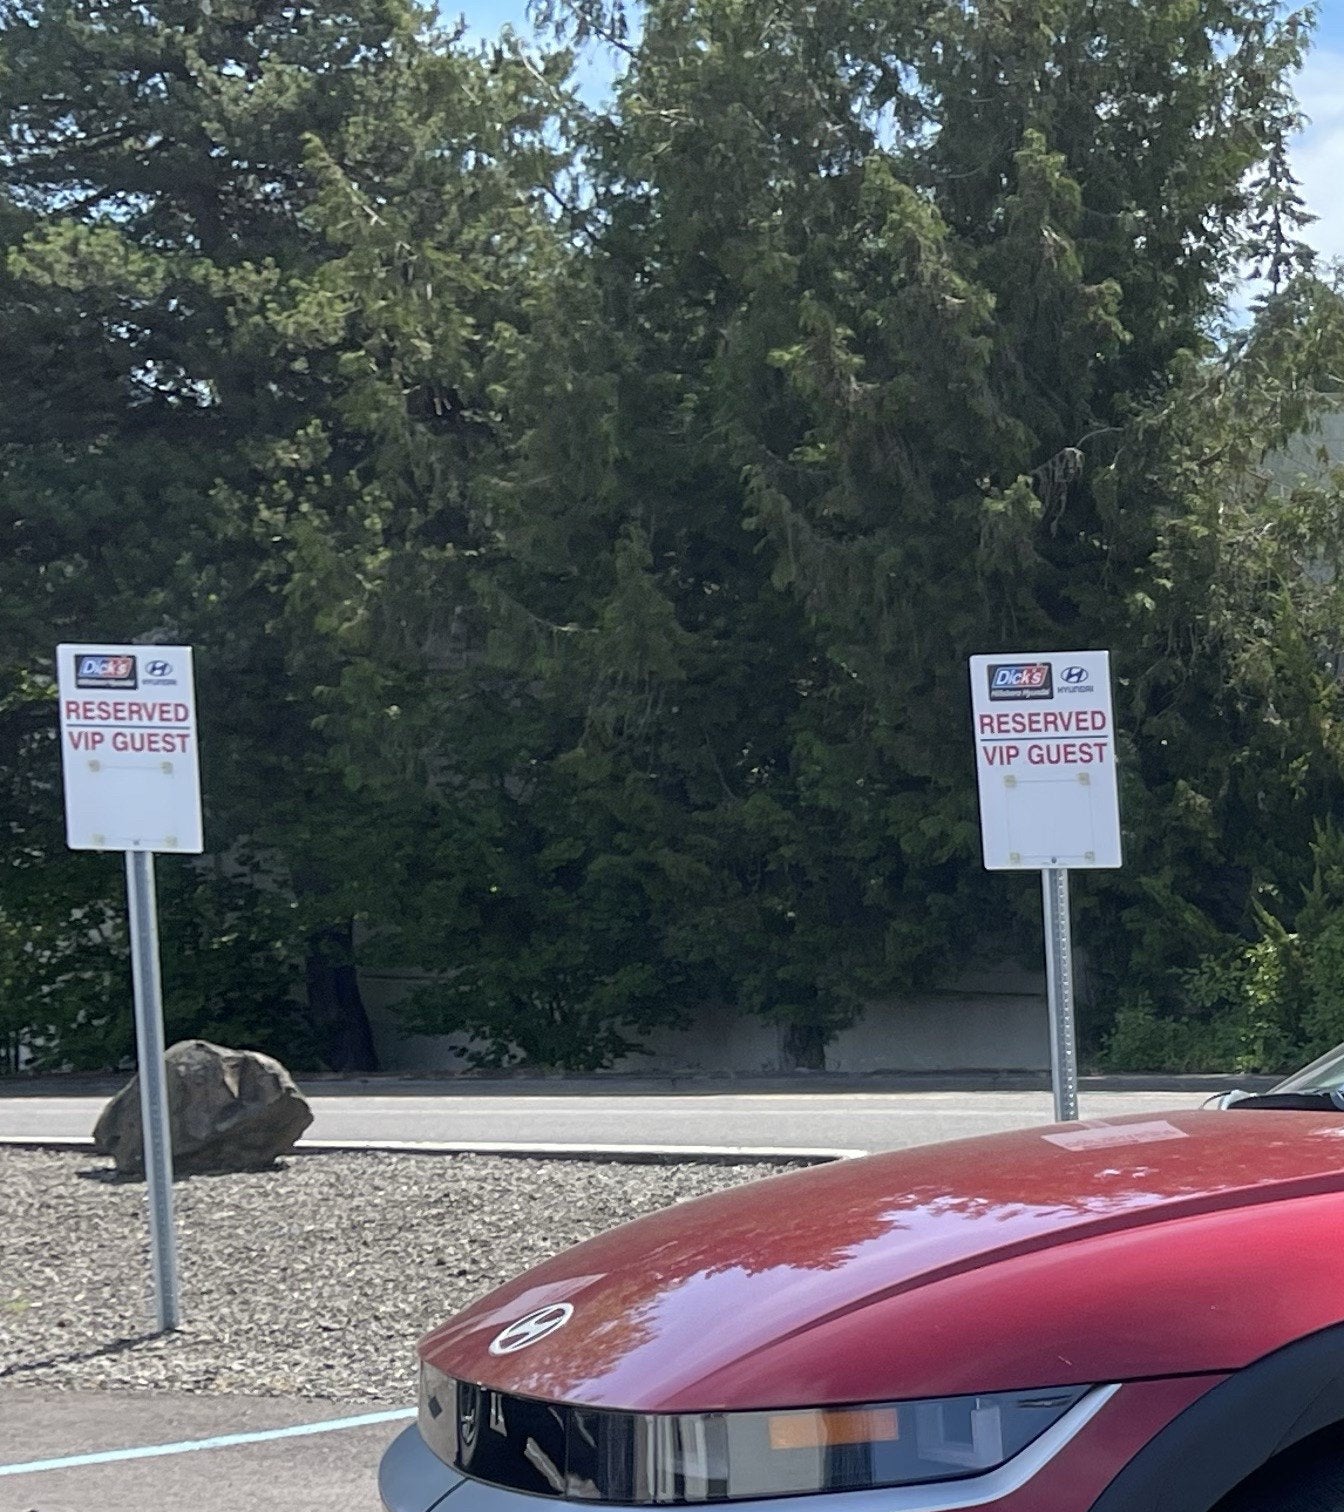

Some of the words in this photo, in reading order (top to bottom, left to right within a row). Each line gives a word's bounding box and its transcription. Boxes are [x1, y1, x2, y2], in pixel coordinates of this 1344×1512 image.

[995, 668, 1042, 685] Dick's
[65, 700, 189, 722] RESERVED
[979, 711, 1107, 734] RESERVED
[68, 731, 104, 751] VIP
[112, 733, 190, 753] GUEST
[983, 745, 1019, 766] VIP
[1027, 743, 1108, 765] GUEST
